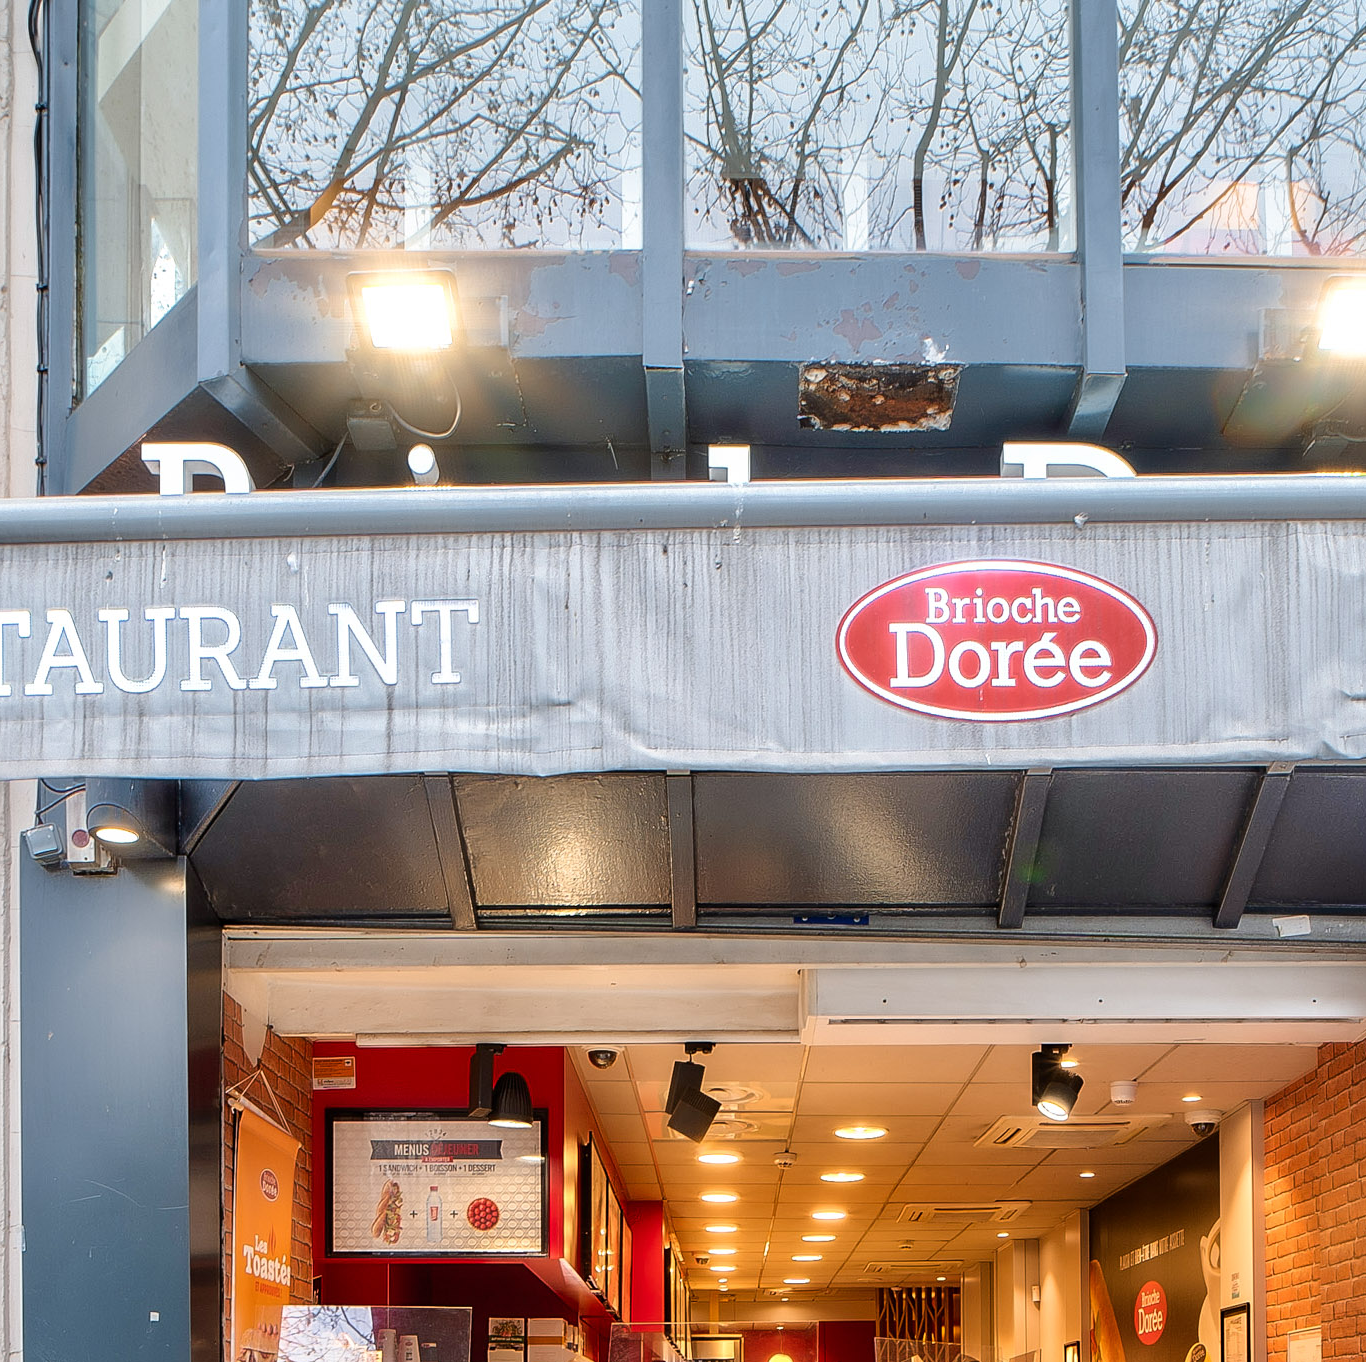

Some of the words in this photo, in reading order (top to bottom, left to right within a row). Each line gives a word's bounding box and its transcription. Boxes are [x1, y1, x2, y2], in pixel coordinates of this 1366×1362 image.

[925, 587, 1081, 625] Brioche
[888, 622, 1114, 690] Dorée
[394, 1143, 430, 1156] MENUS
[383, 1164, 418, 1173] SANDWICH
[429, 1164, 457, 1173] BOISSON
[468, 1164, 496, 1172] DESSERT
[254, 1234, 268, 1255] Les
[1141, 1288, 1161, 1308] Brioche
[1138, 1308, 1163, 1335] Dorée
